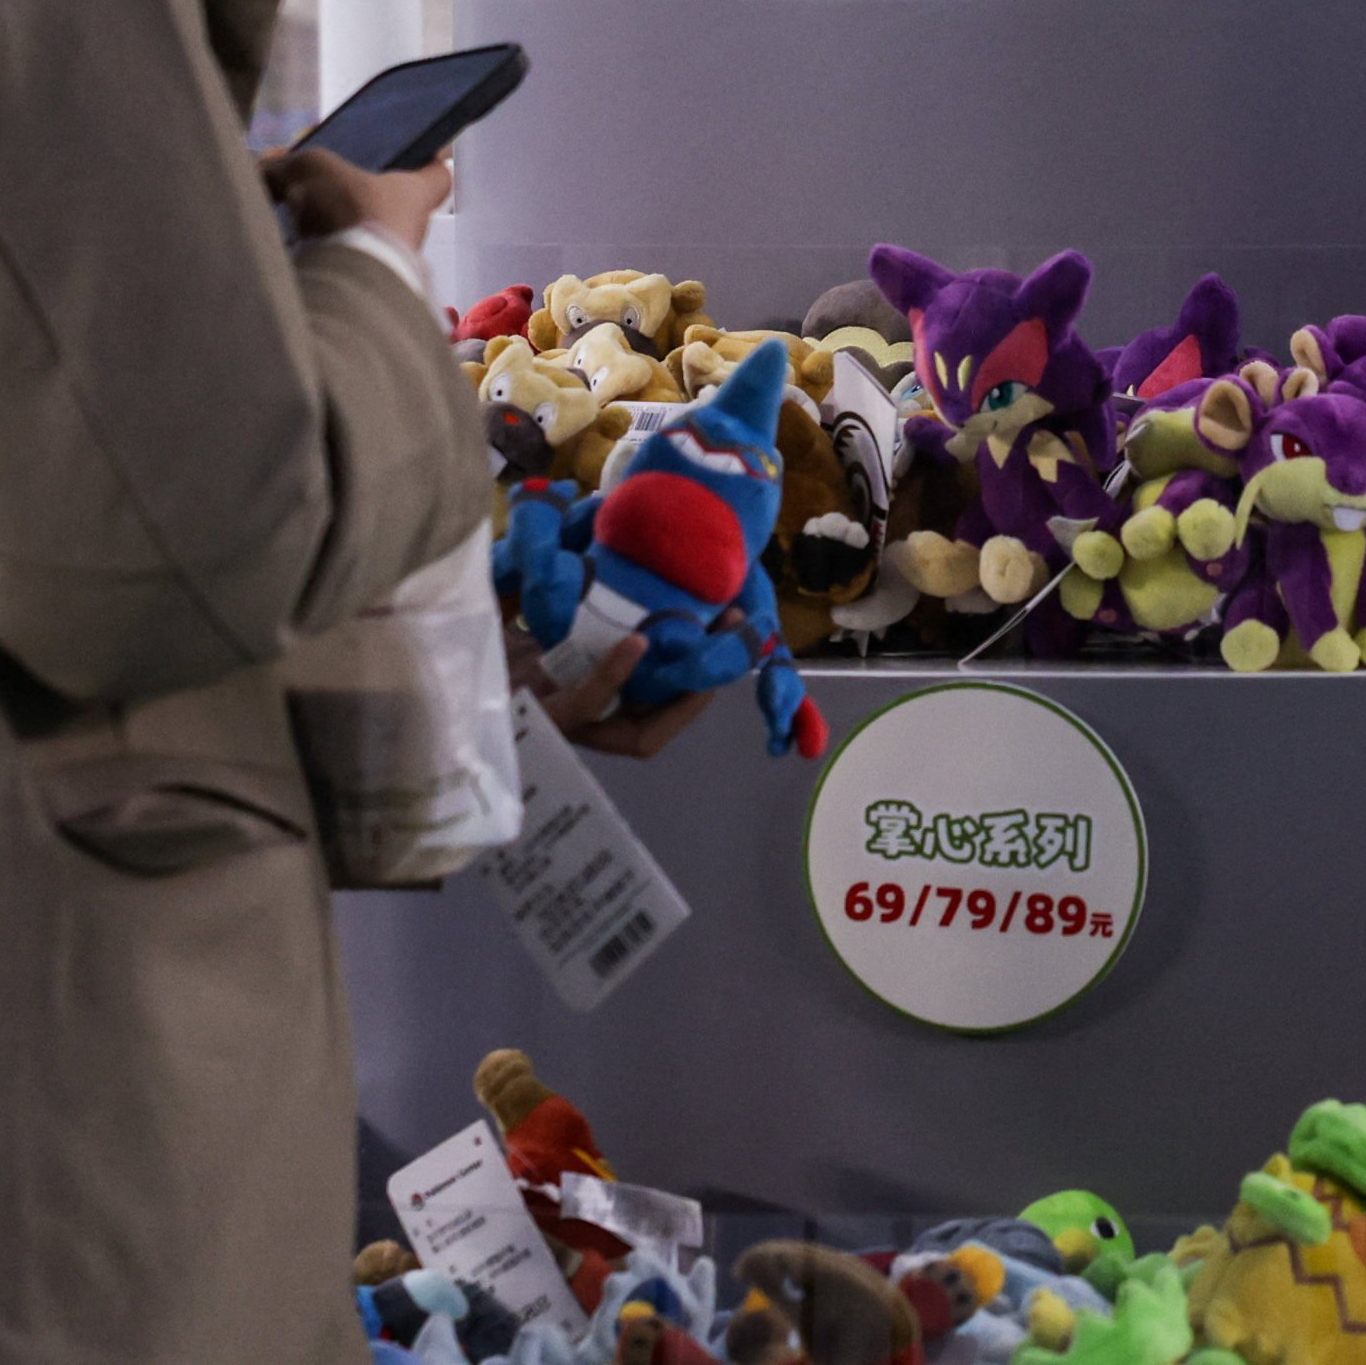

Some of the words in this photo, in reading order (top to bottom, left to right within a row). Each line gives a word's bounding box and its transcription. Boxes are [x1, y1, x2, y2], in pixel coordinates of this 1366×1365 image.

[865, 799, 1093, 873] 掌心系列
[844, 881, 1114, 939] 69/79/89元
